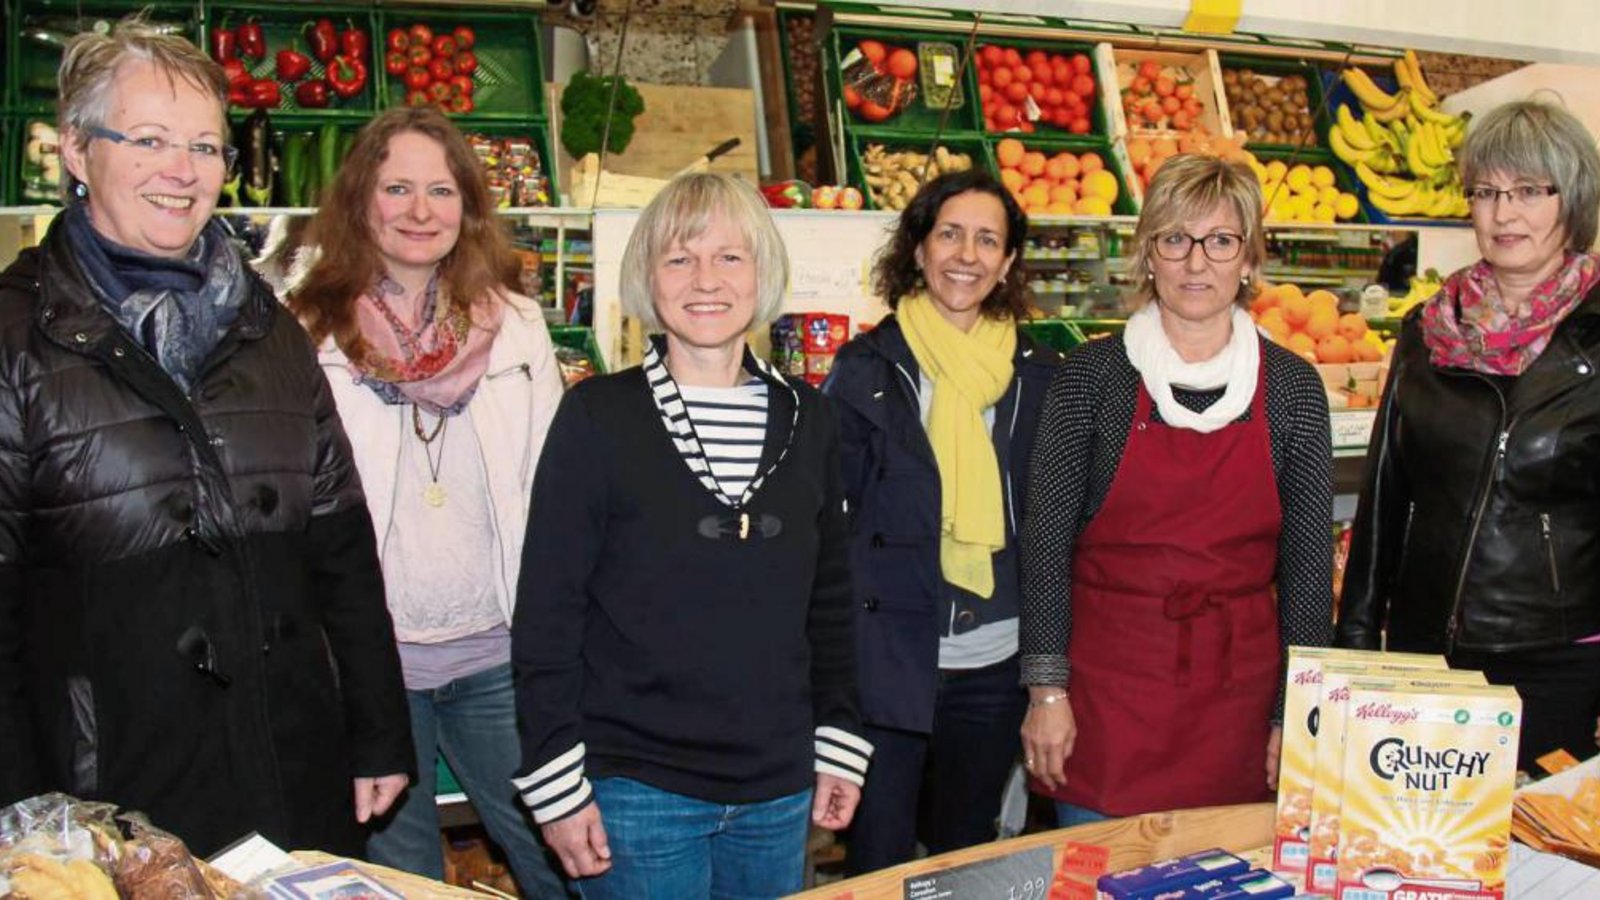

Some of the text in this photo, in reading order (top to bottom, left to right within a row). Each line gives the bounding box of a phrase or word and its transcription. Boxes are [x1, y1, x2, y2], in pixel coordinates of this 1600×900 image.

[1355, 702, 1419, 724] Kellogg's
[1369, 737, 1491, 781] CRUNCHY
[1405, 772, 1452, 791] NUT
